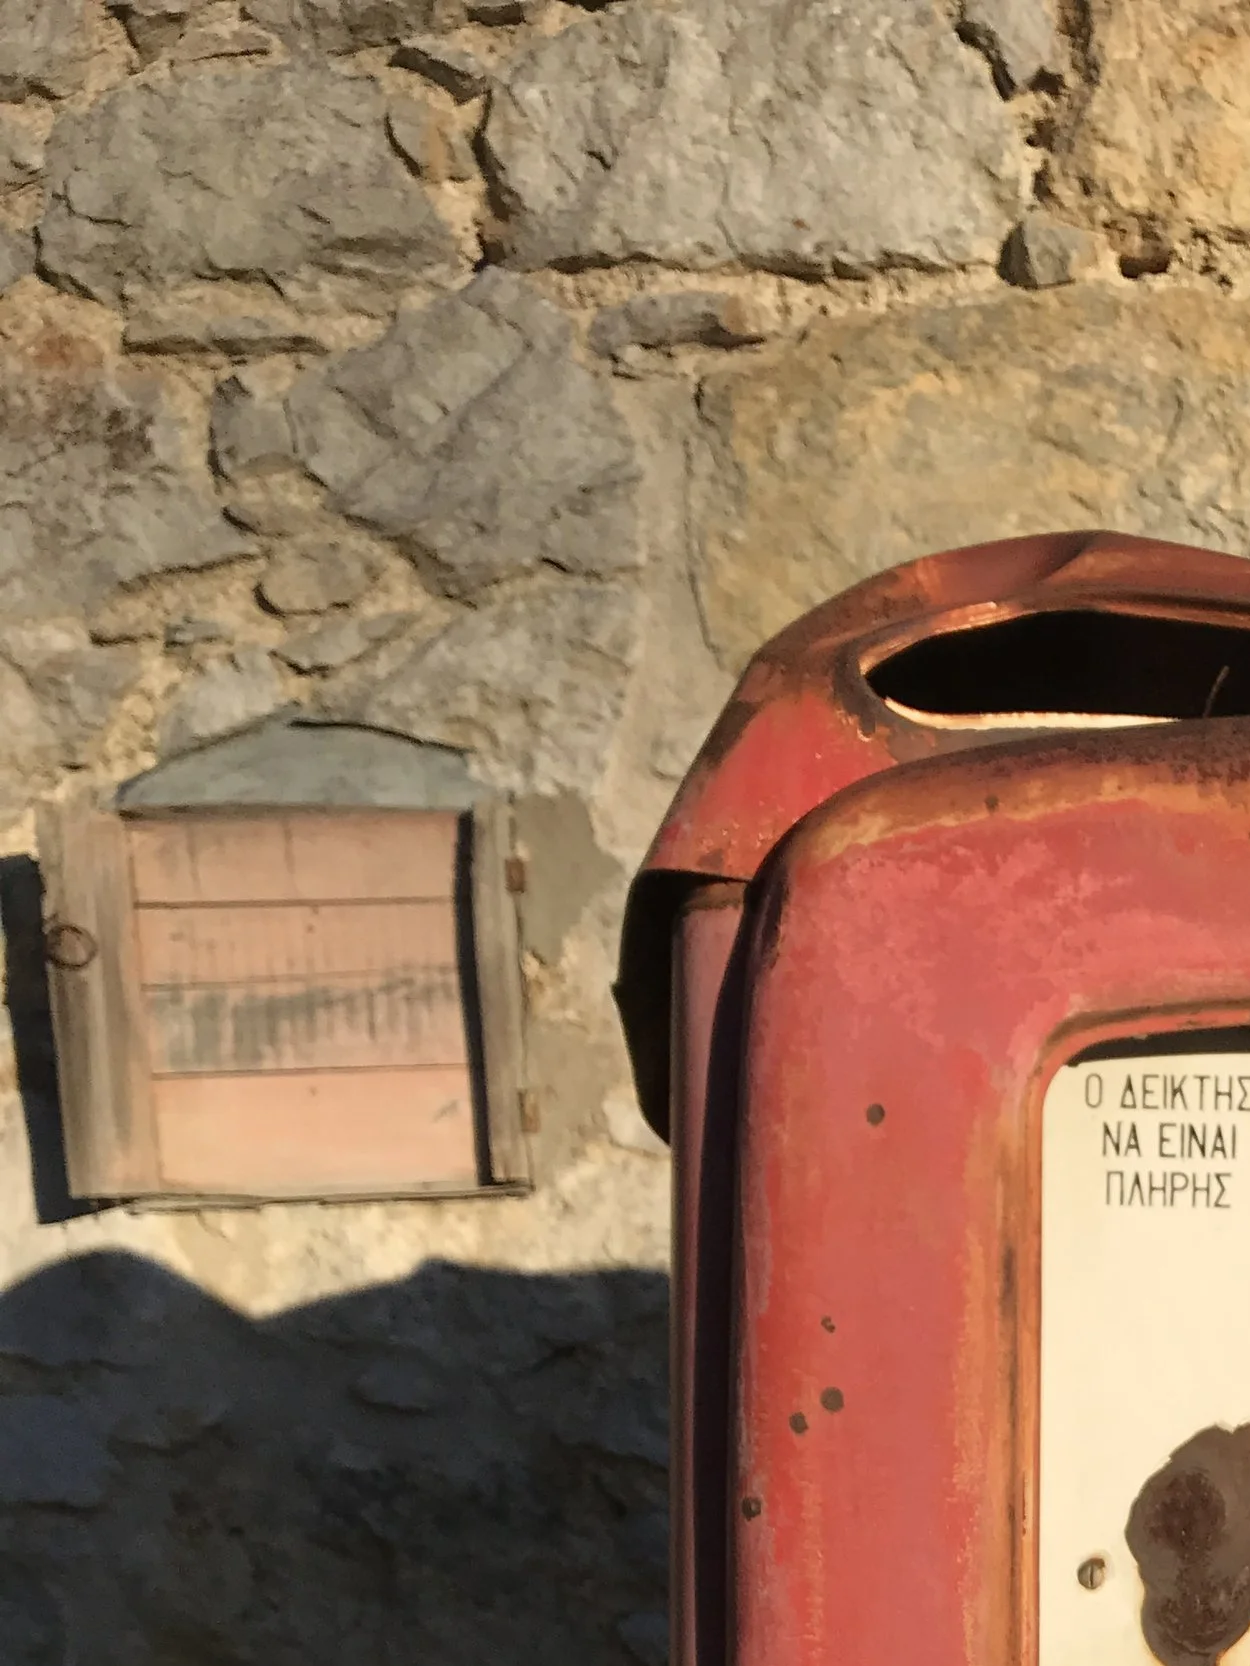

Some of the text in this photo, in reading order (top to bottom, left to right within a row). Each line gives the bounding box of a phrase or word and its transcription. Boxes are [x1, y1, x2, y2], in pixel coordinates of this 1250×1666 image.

[1102, 1121, 1236, 1159] ΝΑ ΕΙΝΑΙ
[1106, 1171, 1232, 1208] ΠΛΗΡΗΣ
